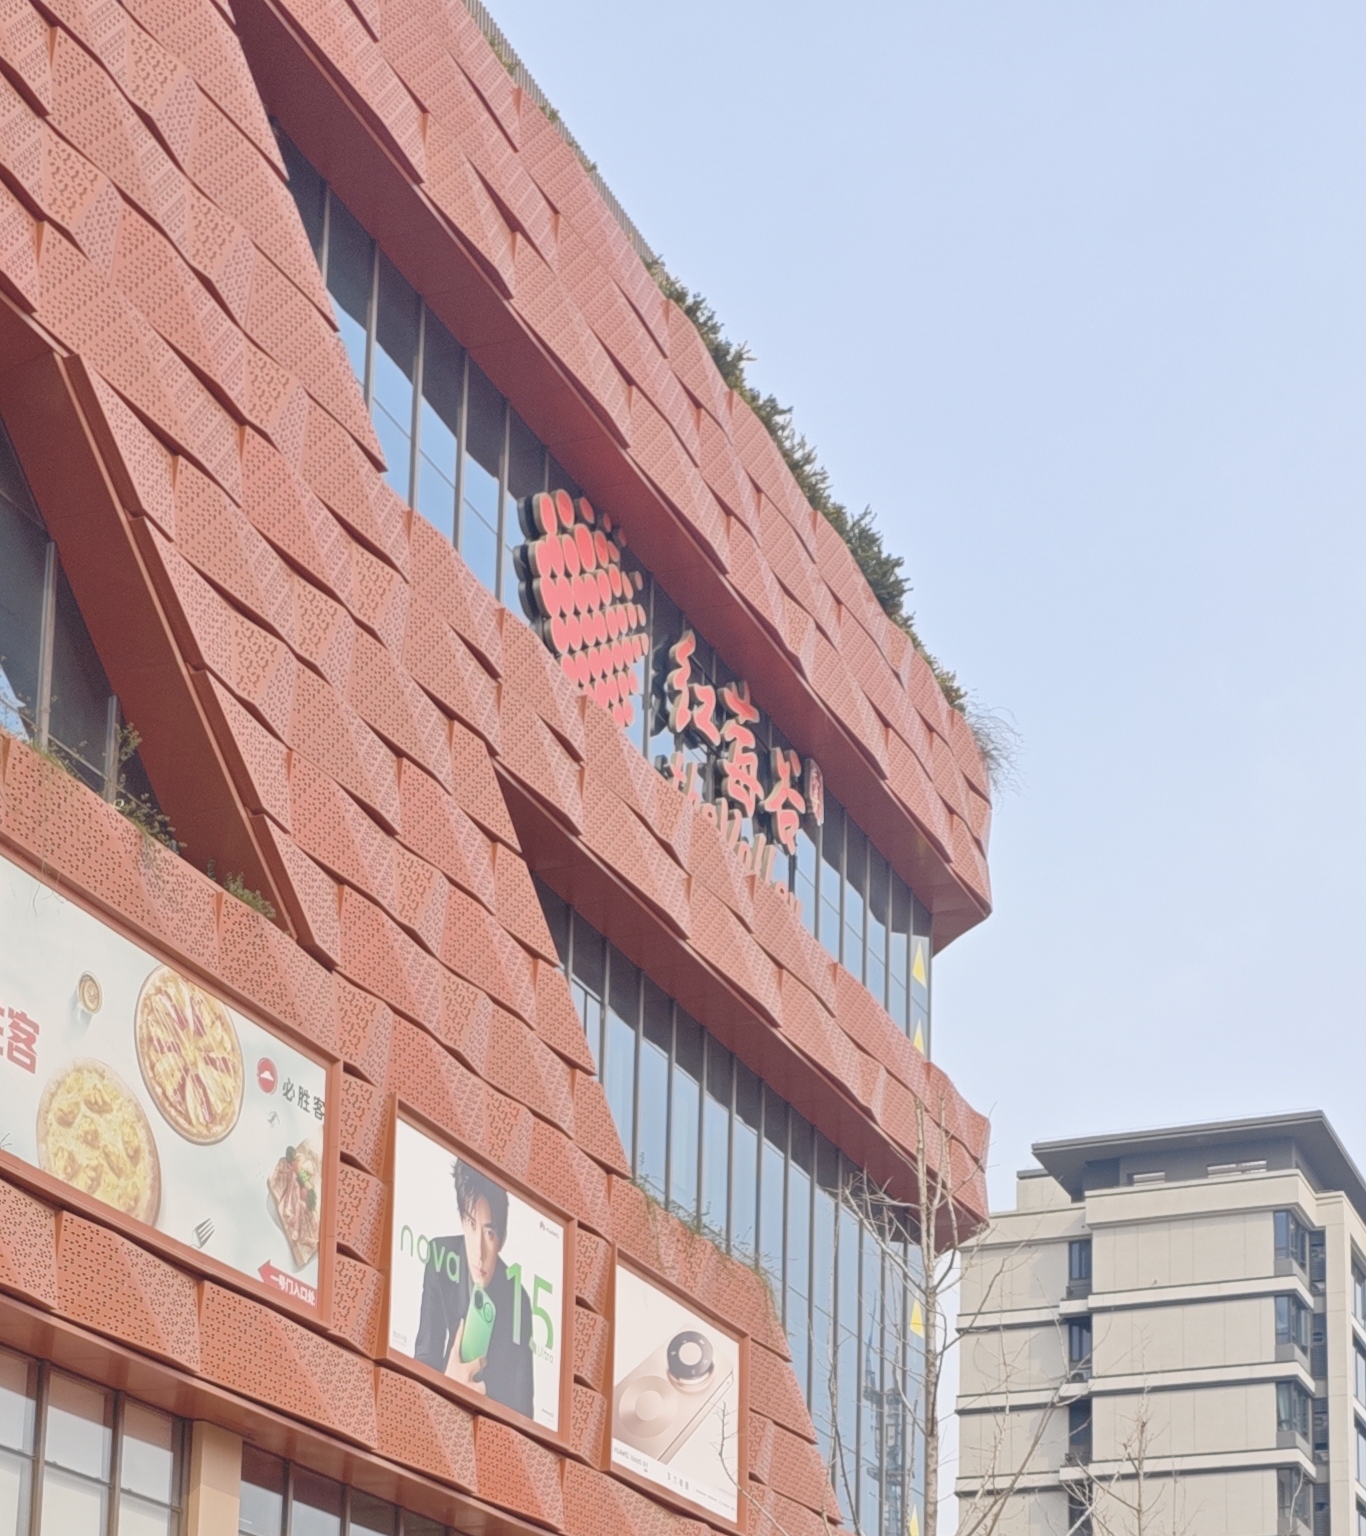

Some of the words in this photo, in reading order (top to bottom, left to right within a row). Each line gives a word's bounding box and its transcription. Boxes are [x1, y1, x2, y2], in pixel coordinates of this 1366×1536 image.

[283, 1077, 325, 1121] 必胜客
[400, 1225, 460, 1284] nova
[506, 1262, 554, 1350] 15
